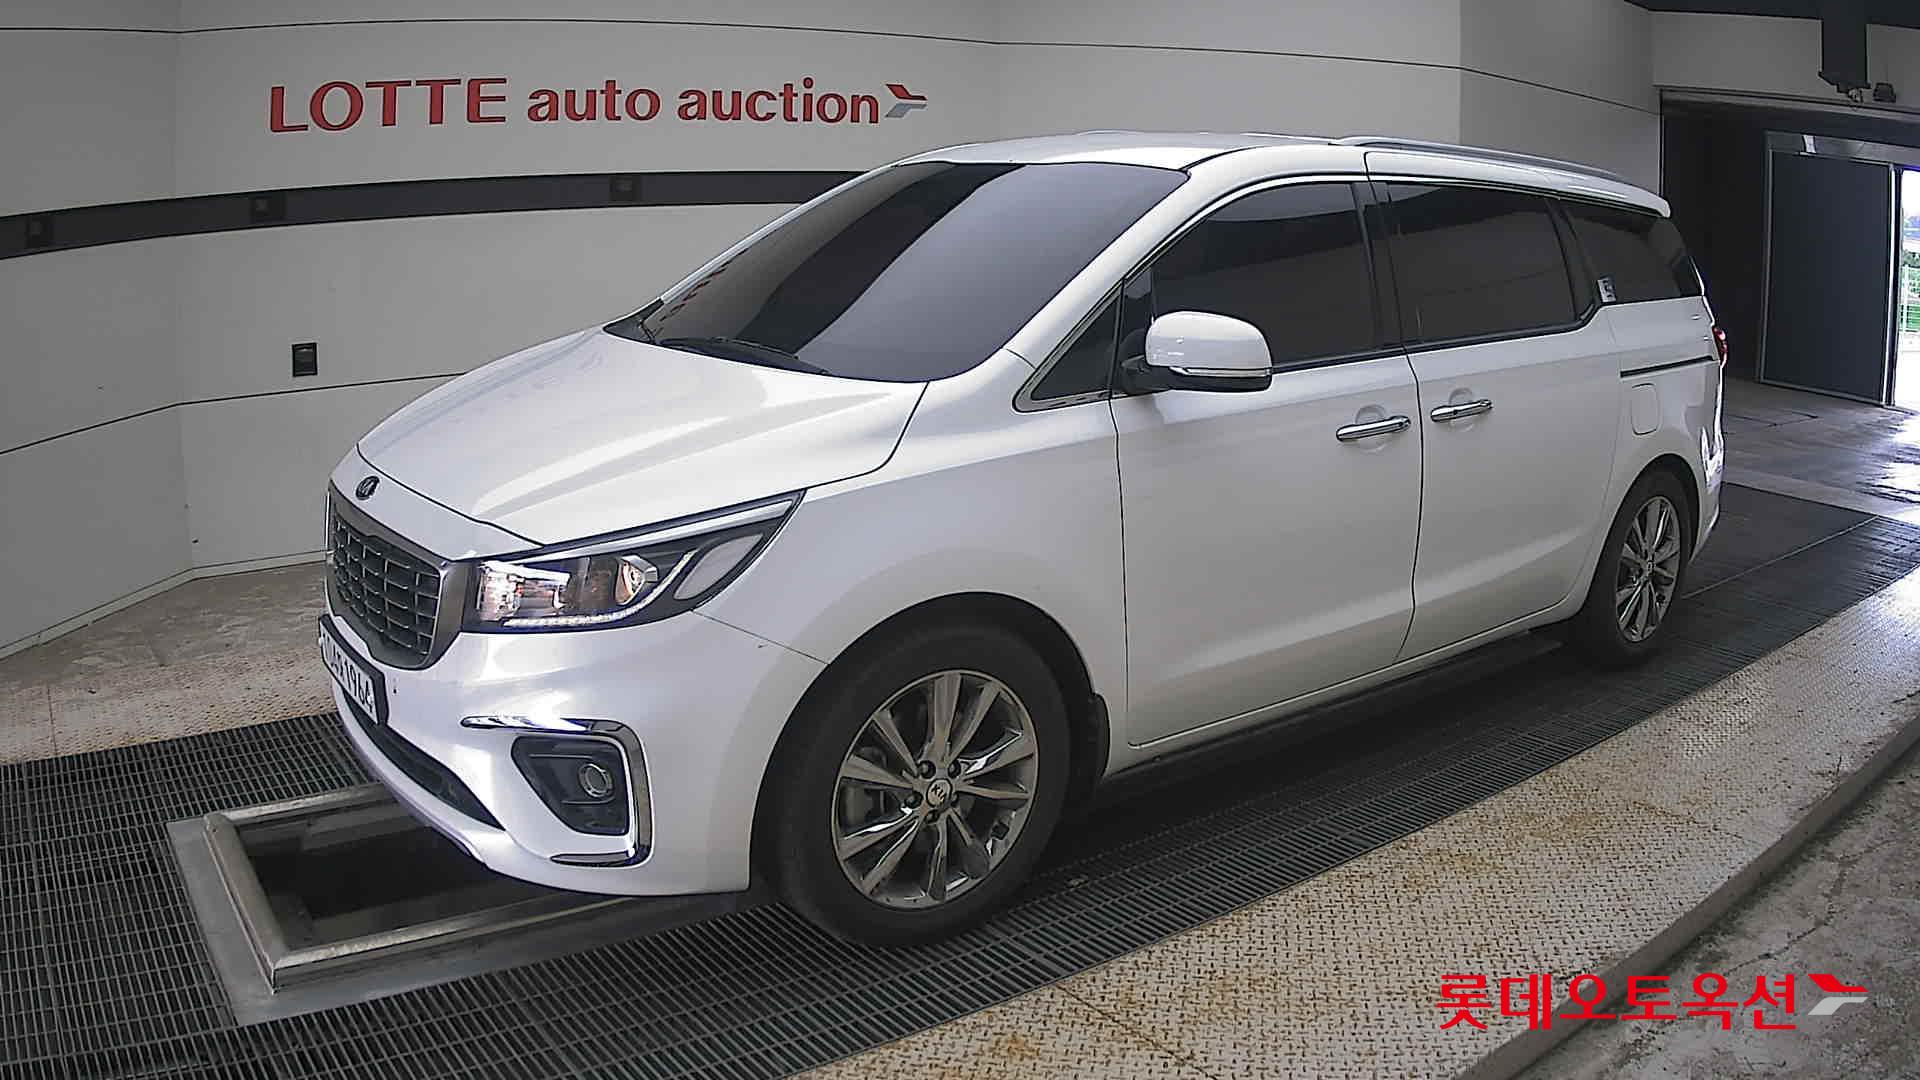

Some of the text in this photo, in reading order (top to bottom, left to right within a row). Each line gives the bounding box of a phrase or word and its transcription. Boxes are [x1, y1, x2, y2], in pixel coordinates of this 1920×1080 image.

[269, 77, 879, 133] LOTTE auto auction
